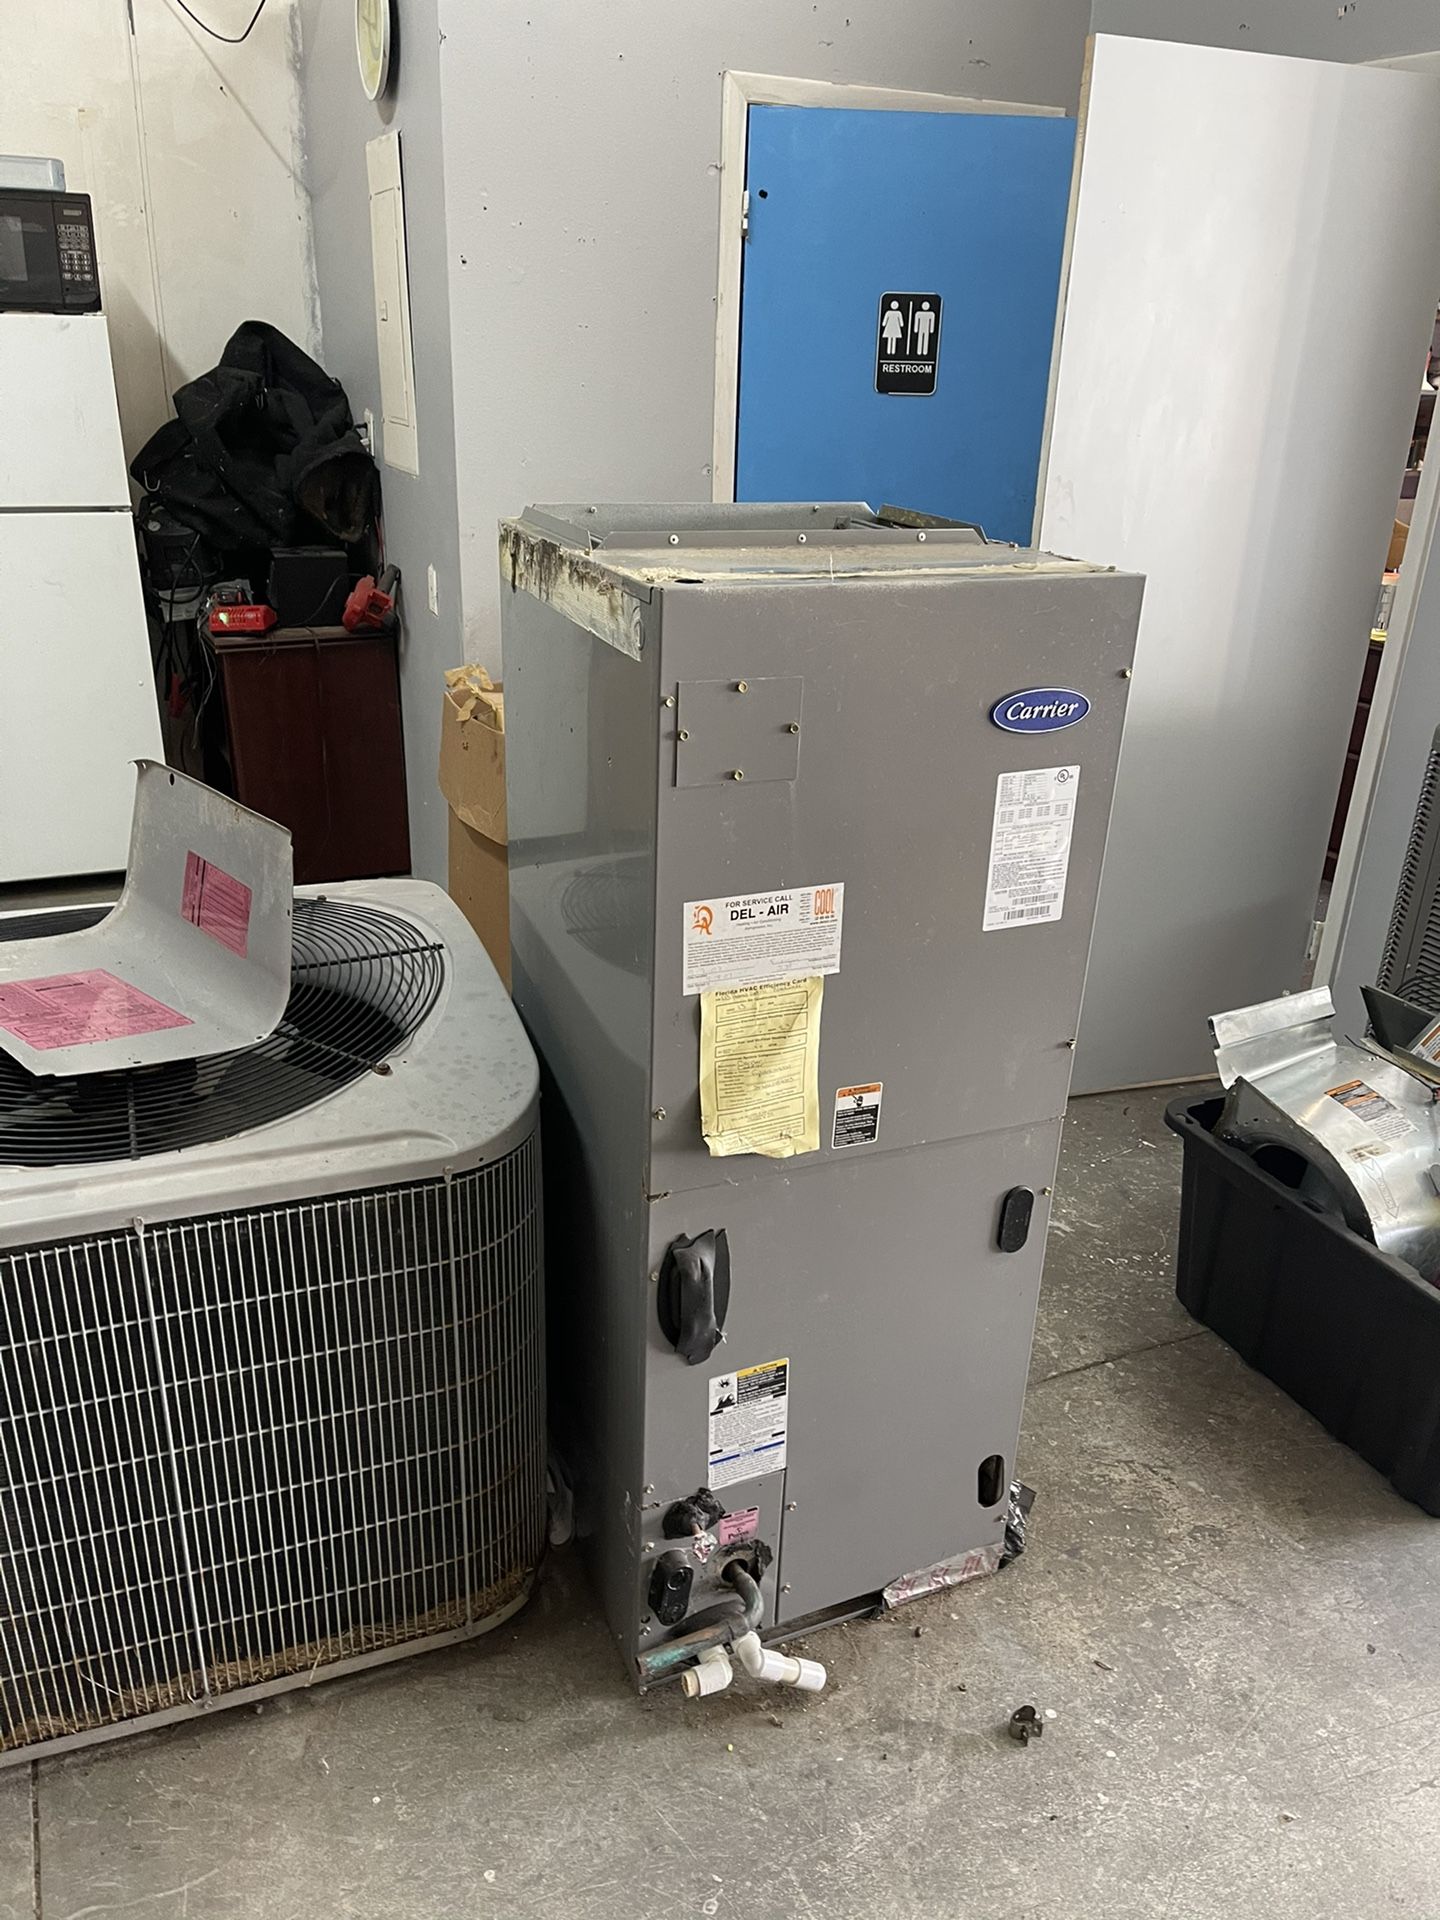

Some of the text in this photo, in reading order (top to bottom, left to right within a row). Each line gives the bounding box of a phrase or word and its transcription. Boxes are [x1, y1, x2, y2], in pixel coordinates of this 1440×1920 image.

[882, 364, 932, 373] RESTROOM
[1006, 700, 1079, 721] Carrier
[742, 897, 773, 906] SERVICE
[775, 894, 793, 903] CALL
[814, 888, 835, 916] COOL
[730, 908, 756, 921] DEL
[767, 903, 789, 916] AIR
[792, 977, 807, 985] Card
